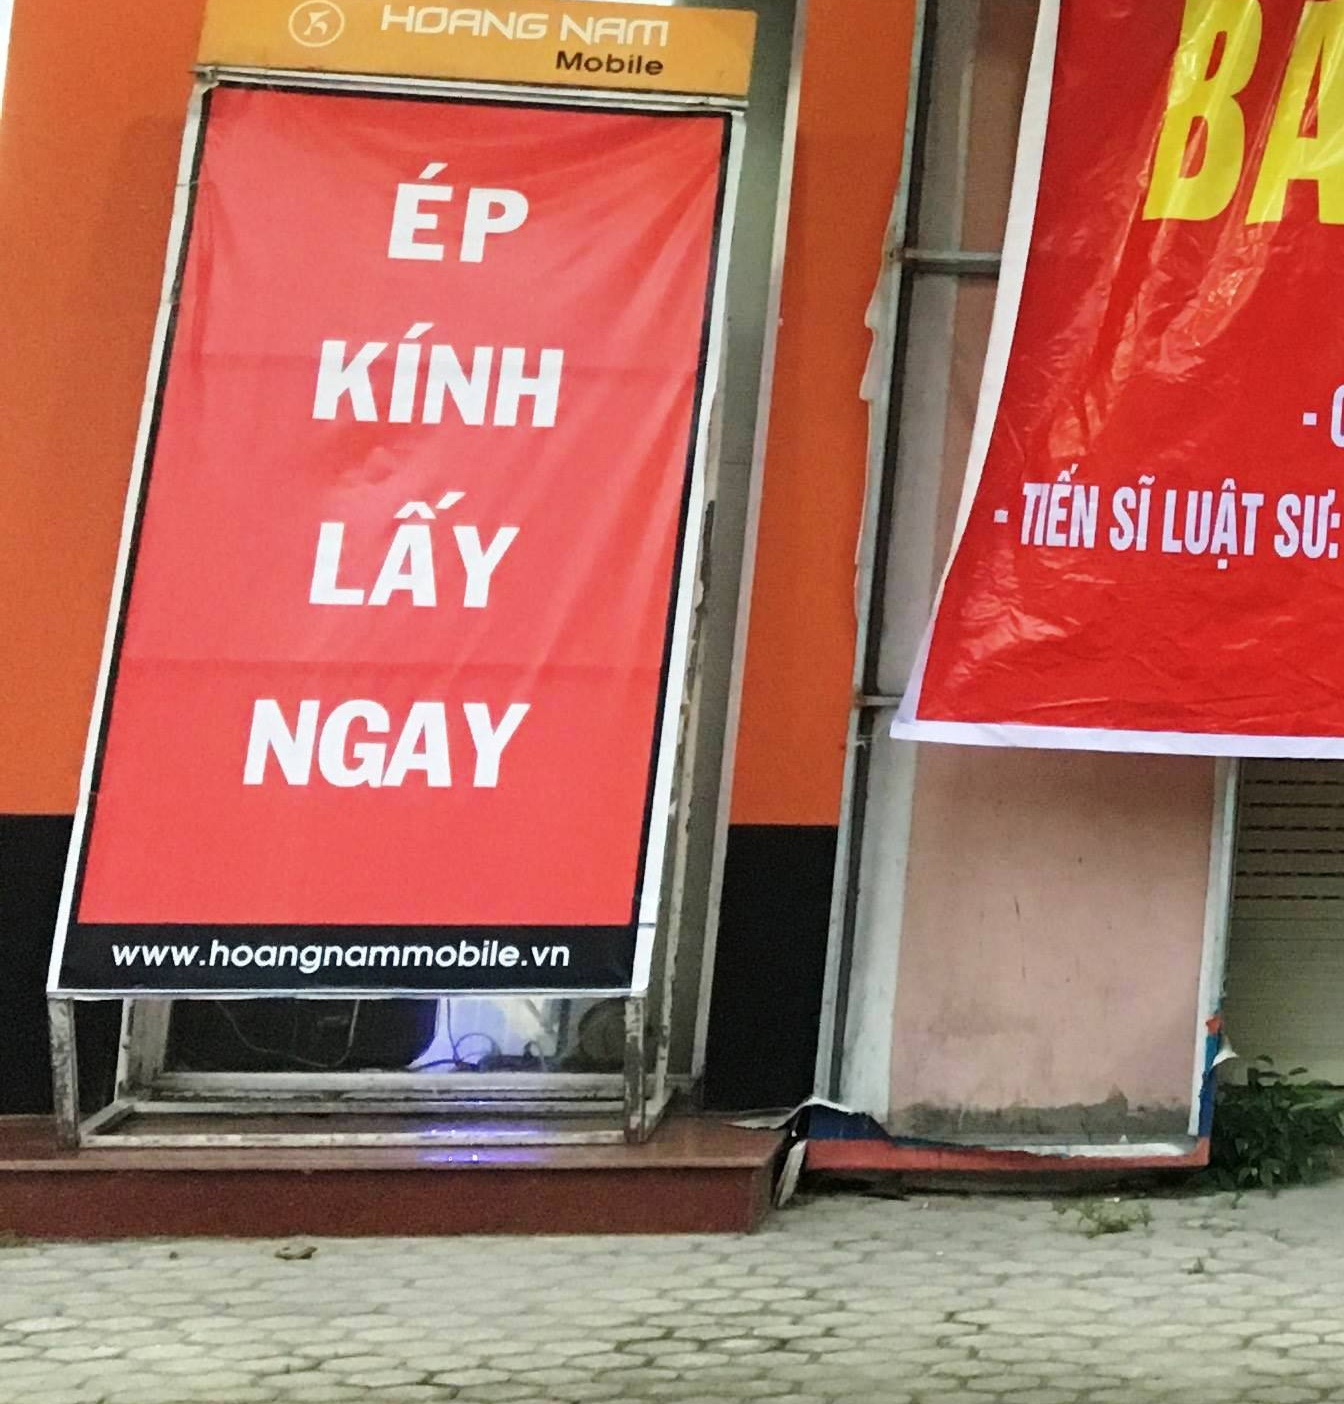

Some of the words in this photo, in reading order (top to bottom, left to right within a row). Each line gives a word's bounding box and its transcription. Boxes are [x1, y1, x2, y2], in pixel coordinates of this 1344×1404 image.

[380, 4, 550, 41] HOANG
[560, 13, 669, 48] NAM
[555, 50, 666, 76] Mobile
[387, 162, 530, 265] ÉP
[311, 321, 565, 429] KÍNH
[308, 490, 521, 610] LẤY
[1021, 461, 1099, 549] TIẾN
[1108, 474, 1156, 552] SĨ
[1161, 477, 1264, 571] LUẬT
[1273, 487, 1340, 560] SƯ:
[242, 697, 531, 790] NGAY
[112, 938, 571, 975] www.hoangnammobile.vn
